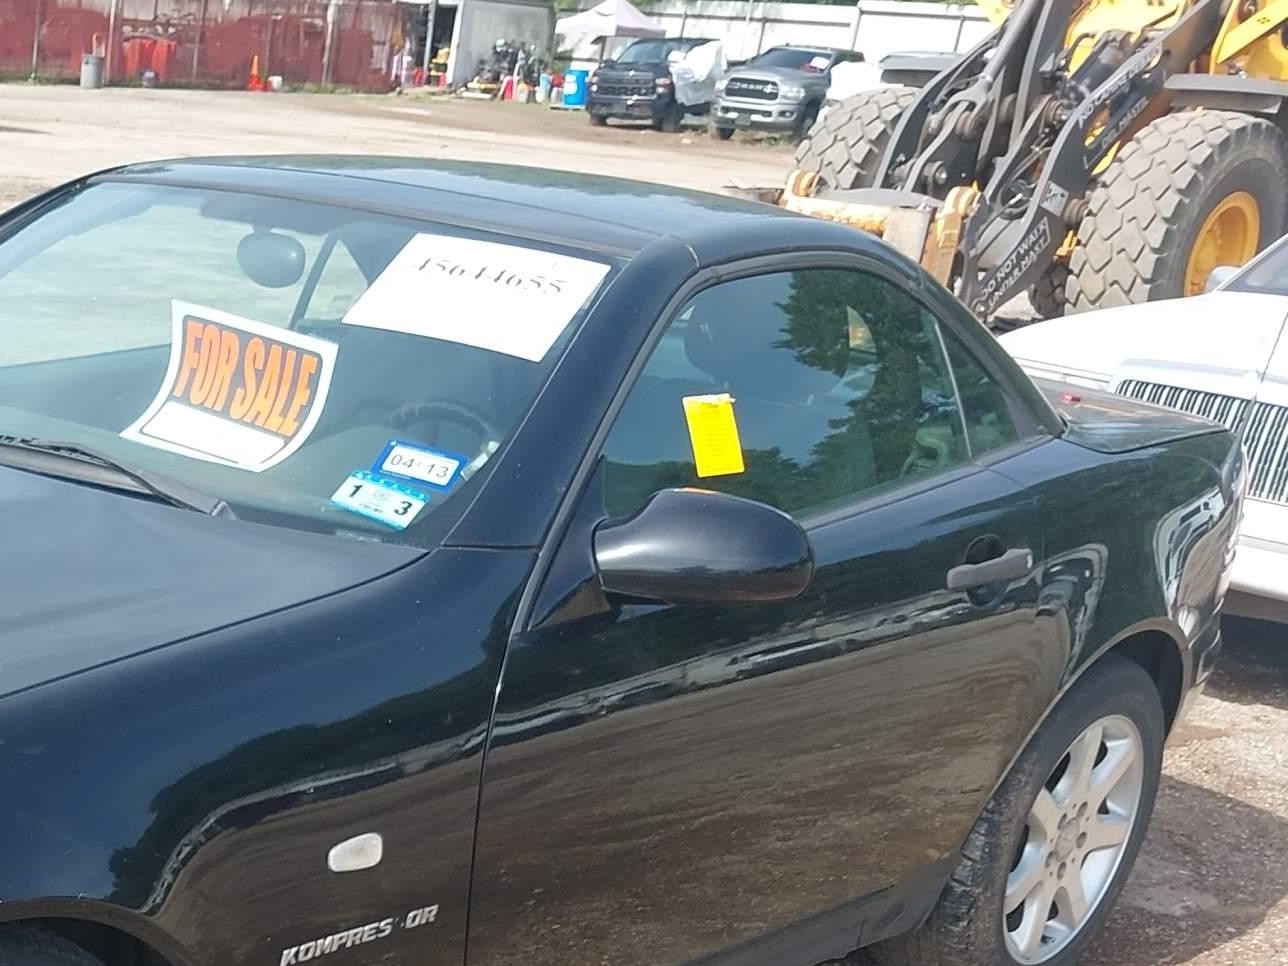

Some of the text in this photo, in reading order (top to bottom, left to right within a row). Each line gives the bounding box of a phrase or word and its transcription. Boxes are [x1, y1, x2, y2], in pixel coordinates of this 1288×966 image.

[996, 250, 1019, 282] NOT
[1018, 222, 1048, 254] WALK
[989, 267, 1023, 308] UNDER
[173, 319, 318, 437] FOR SALE
[394, 500, 413, 516] 3
